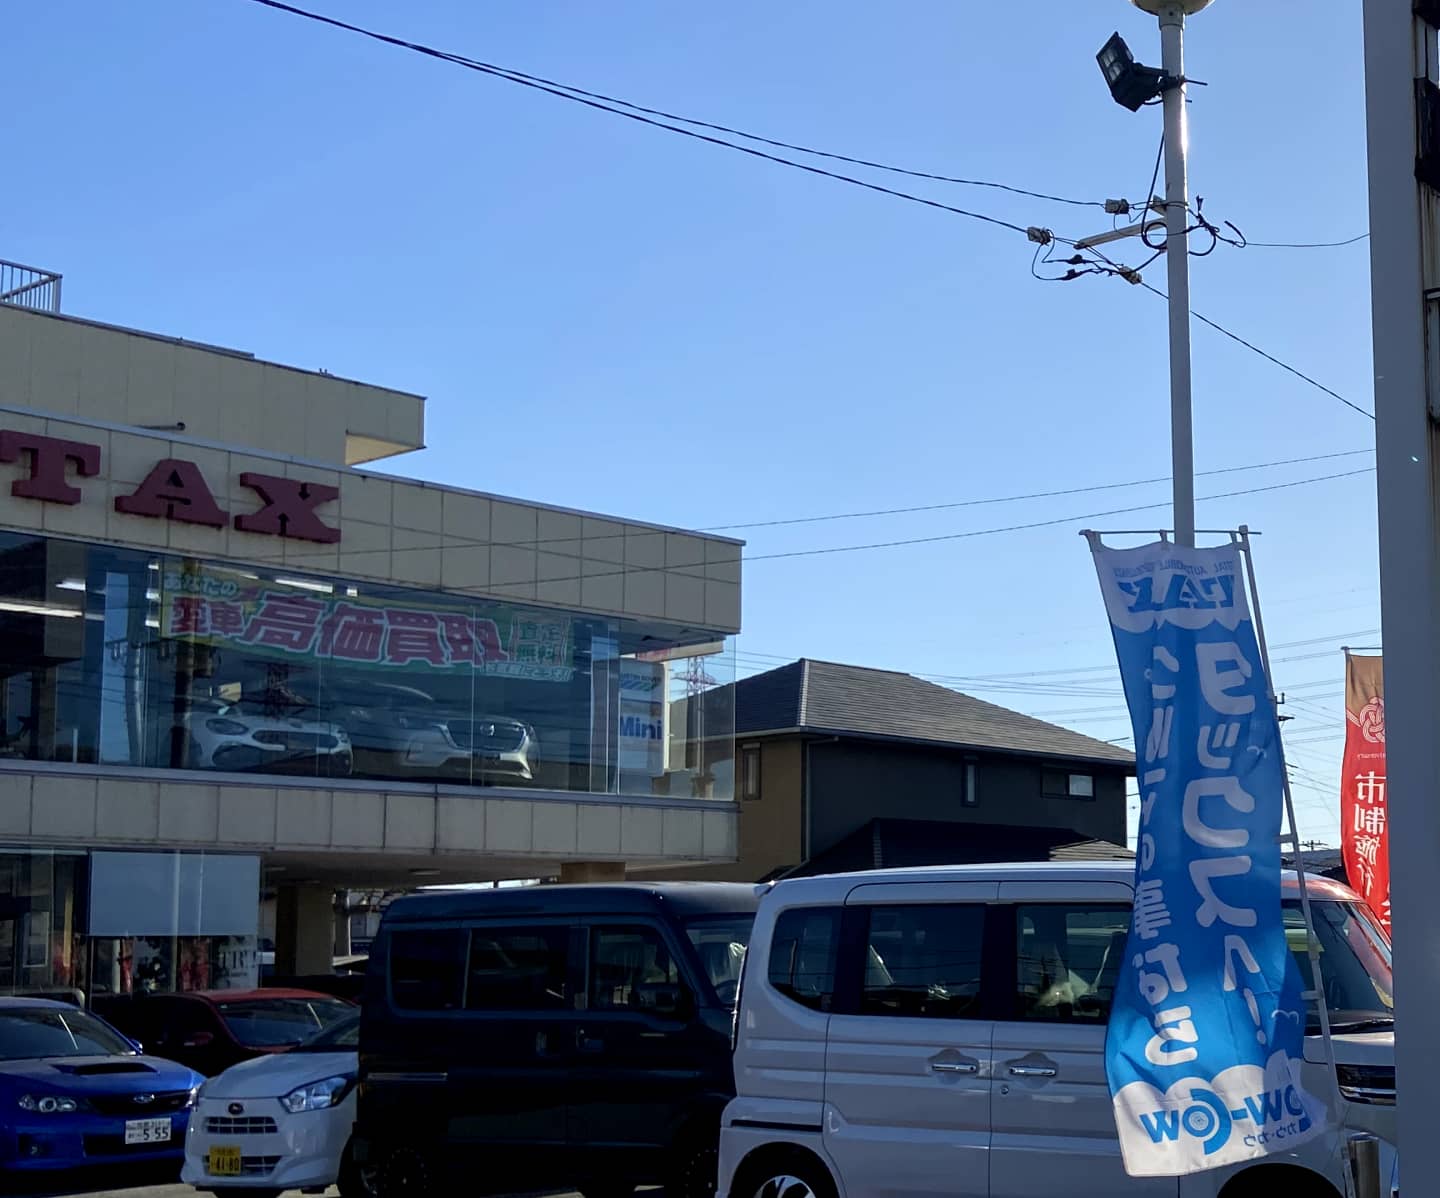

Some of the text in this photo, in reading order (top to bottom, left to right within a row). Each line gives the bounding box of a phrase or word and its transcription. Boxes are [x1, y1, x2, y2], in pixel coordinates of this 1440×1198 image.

[0, 429, 342, 544] TAX
[236, 591, 510, 669] 高価買取
